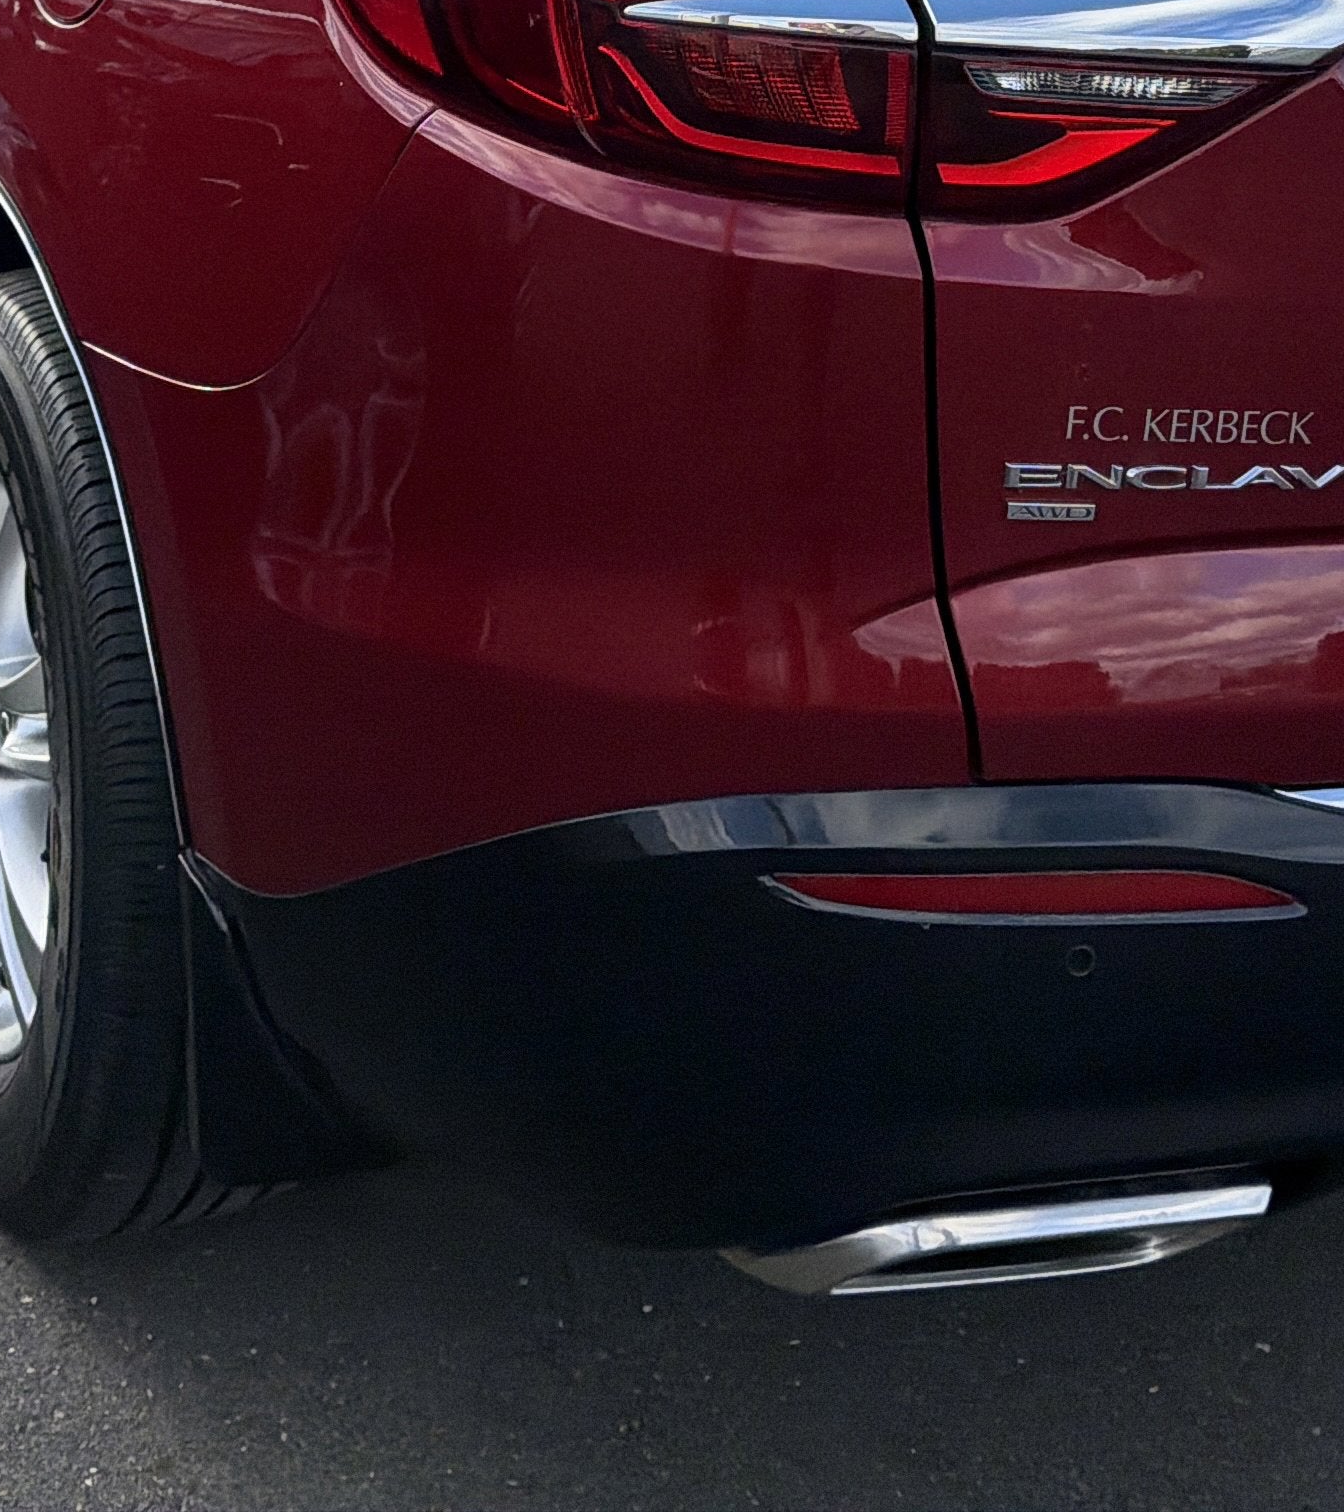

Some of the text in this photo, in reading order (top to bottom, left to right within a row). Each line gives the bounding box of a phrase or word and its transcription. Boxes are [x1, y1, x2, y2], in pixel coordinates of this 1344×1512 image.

[1065, 405, 1315, 445] F.C. KERBECK
[1009, 504, 1093, 519] AWD
